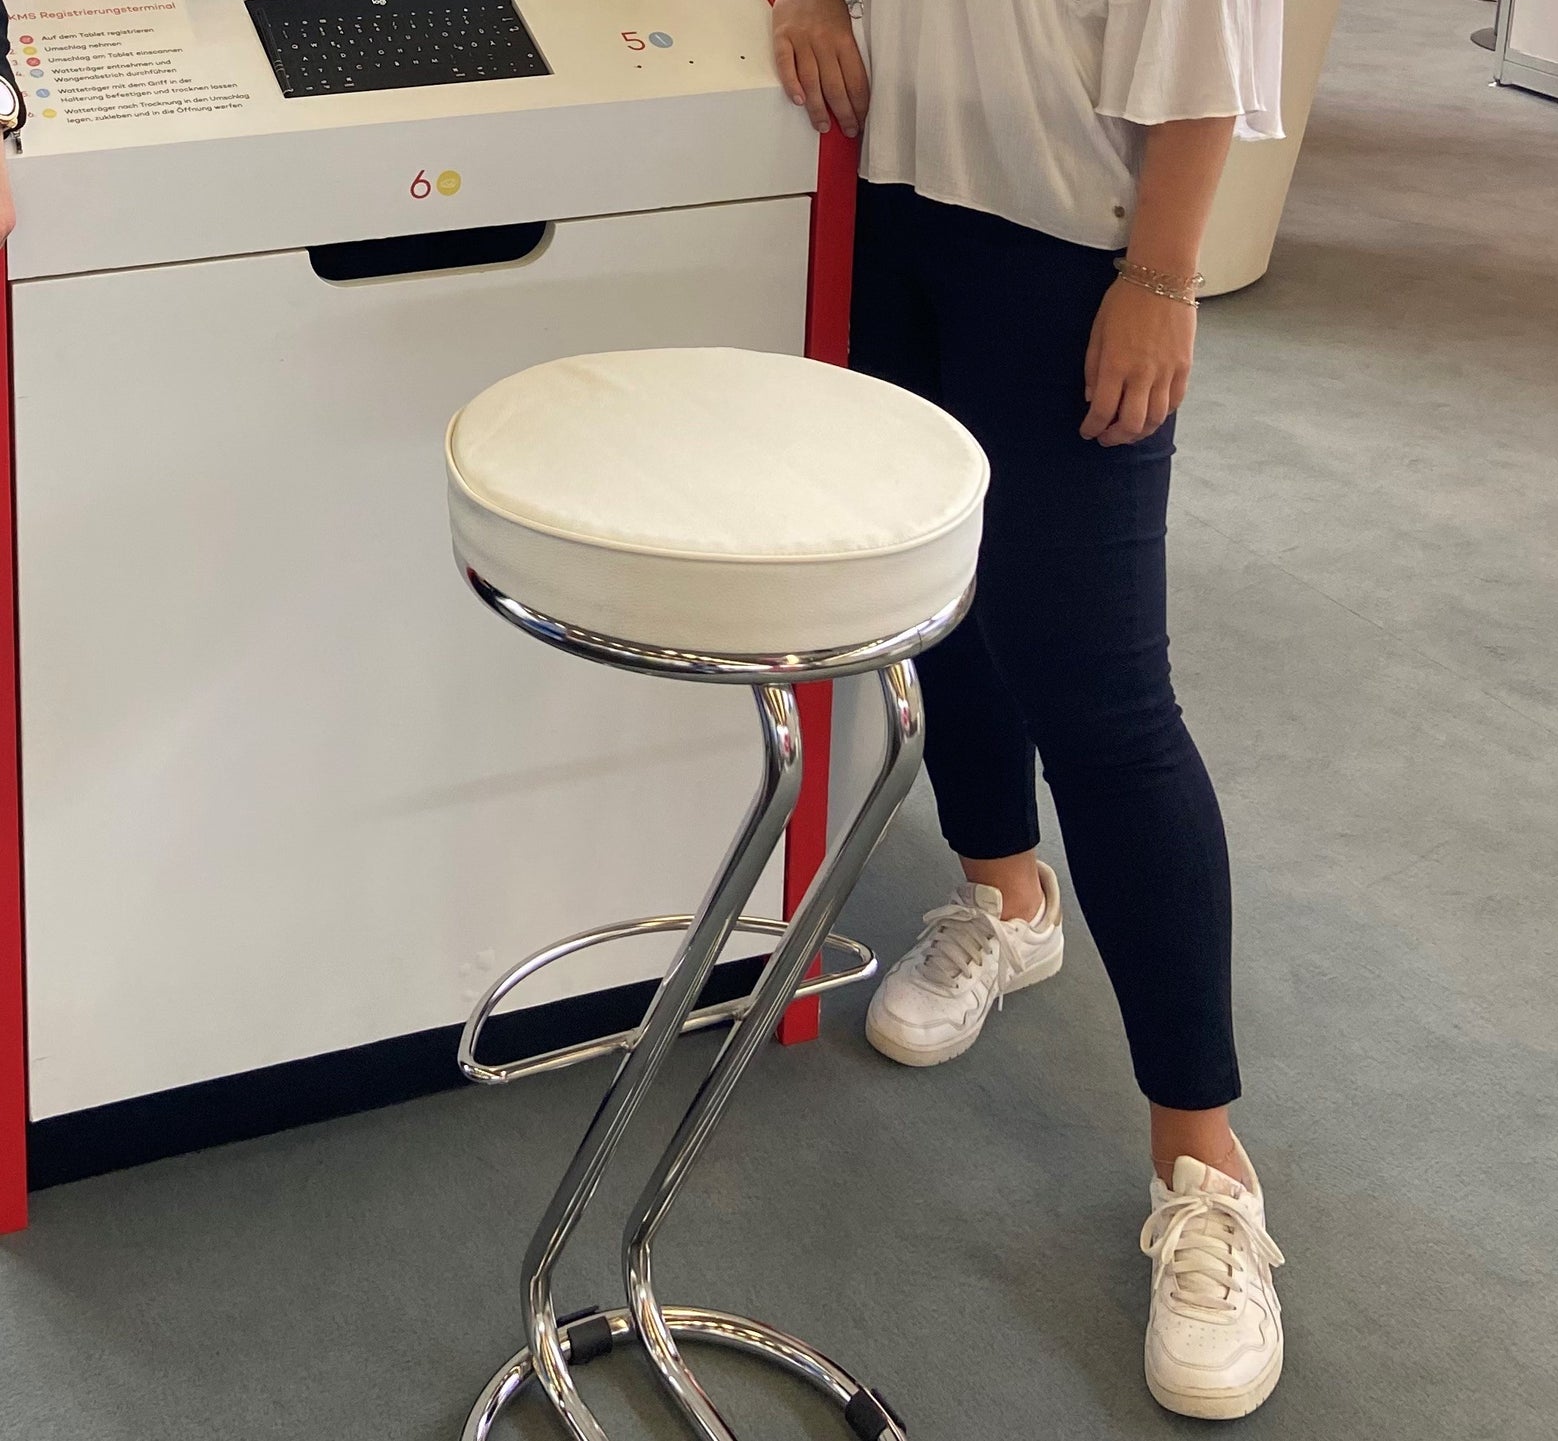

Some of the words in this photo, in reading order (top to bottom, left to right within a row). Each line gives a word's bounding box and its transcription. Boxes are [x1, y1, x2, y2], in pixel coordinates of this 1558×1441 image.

[40, 2, 176, 20] Registrierungsterminal
[621, 31, 646, 51] 5
[410, 169, 431, 199] 6
